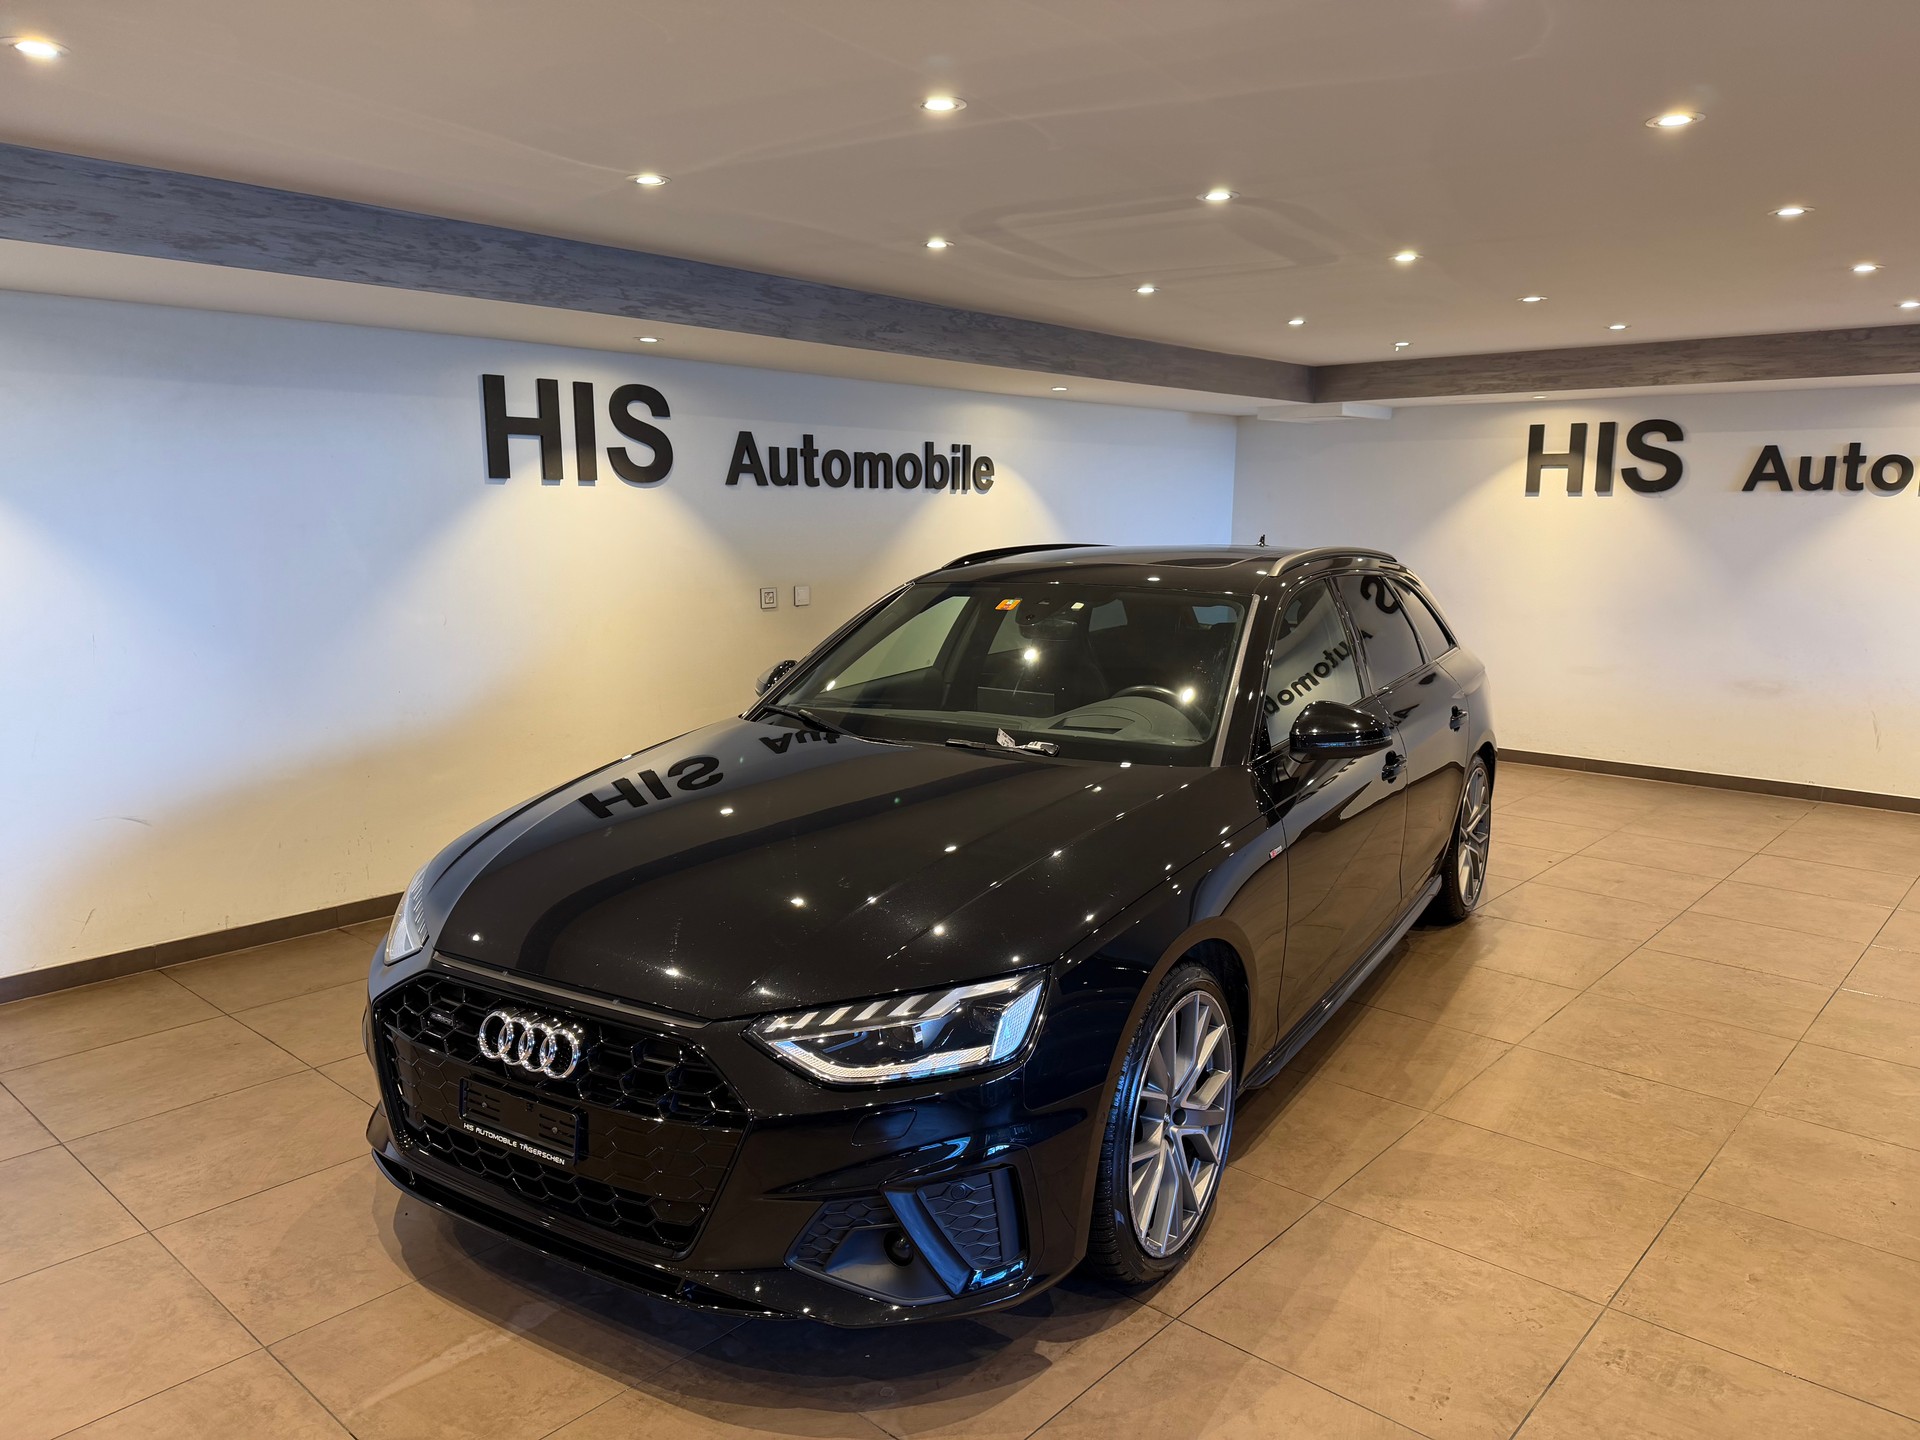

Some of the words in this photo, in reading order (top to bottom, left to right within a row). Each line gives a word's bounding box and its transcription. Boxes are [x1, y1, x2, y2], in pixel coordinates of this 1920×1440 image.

[481, 373, 674, 485] HIS
[726, 431, 994, 491] Automobile
[1525, 418, 1684, 494] HIS
[1742, 442, 1920, 492] Auto
[463, 1122, 474, 1132] HIS
[475, 1127, 517, 1148] AUTOMOBILE
